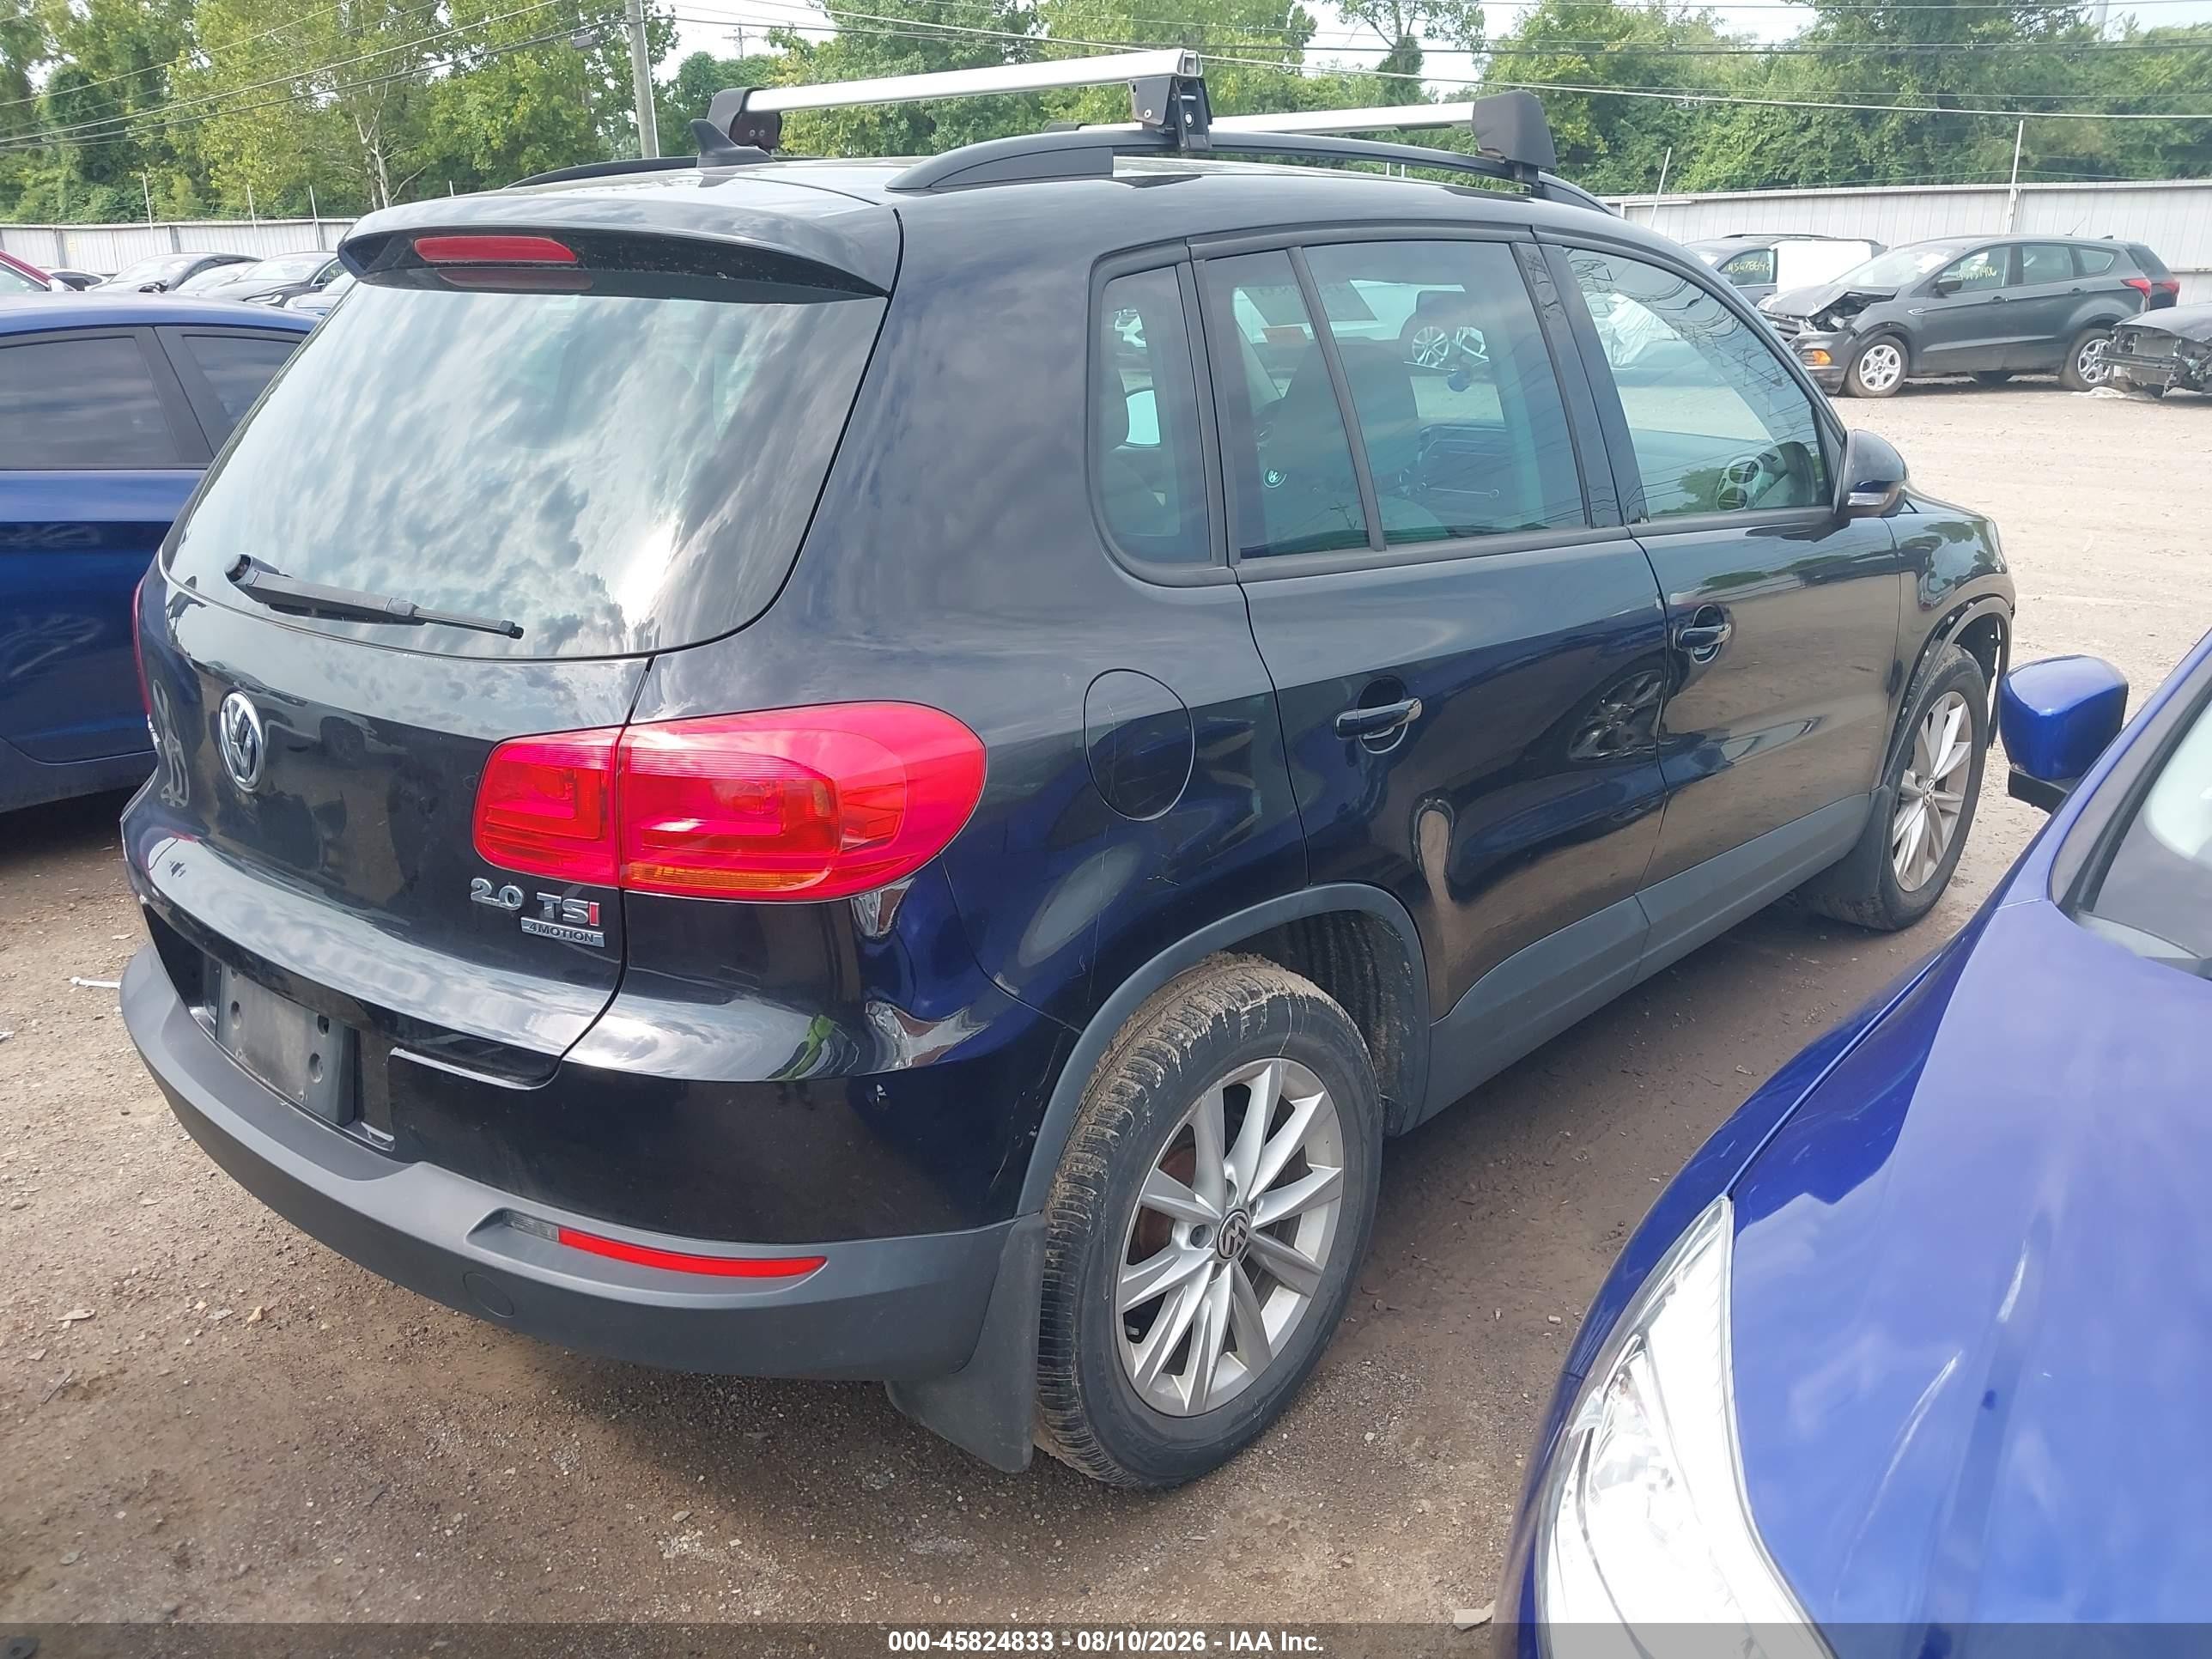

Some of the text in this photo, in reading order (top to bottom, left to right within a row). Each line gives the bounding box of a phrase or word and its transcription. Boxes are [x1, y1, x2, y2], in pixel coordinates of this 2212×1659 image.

[471, 878, 600, 927] 2.0 TSI
[528, 921, 594, 944] 4MOTION
